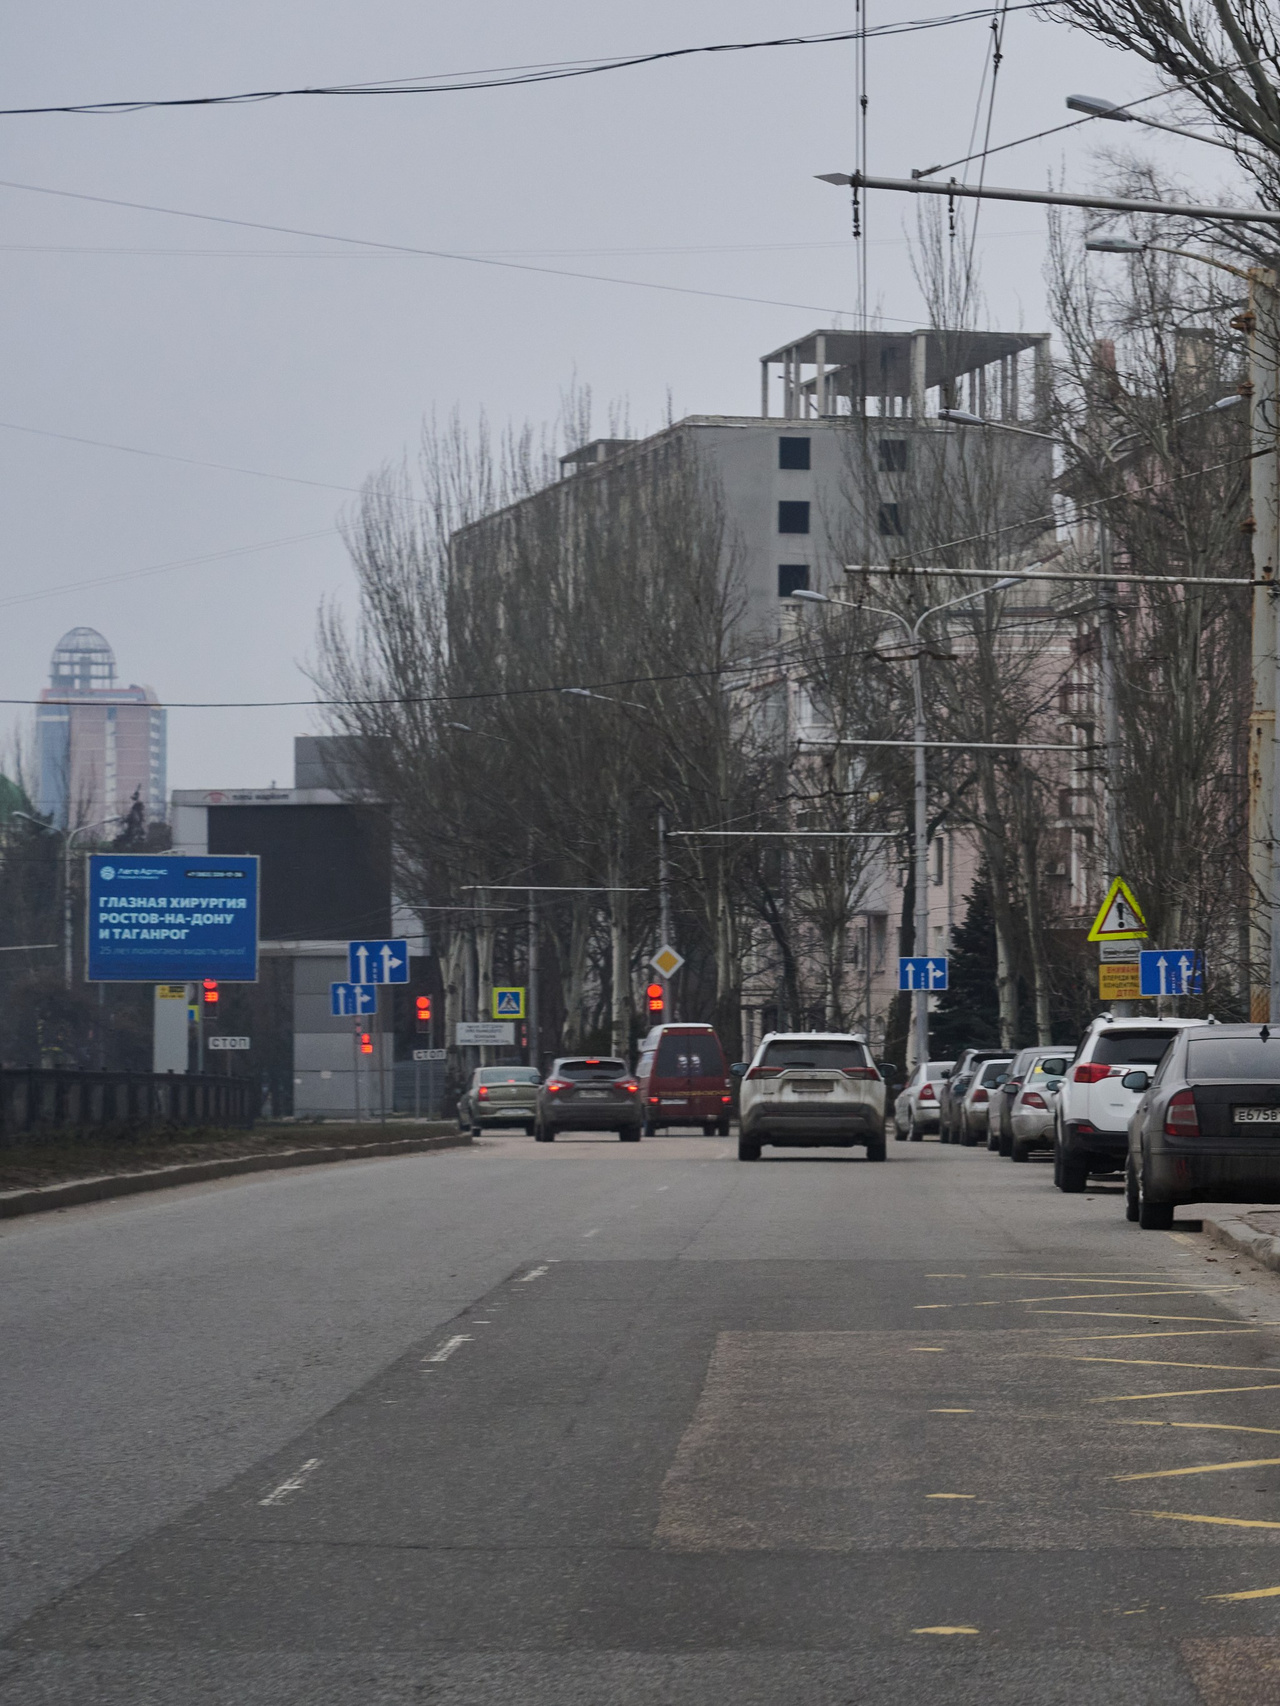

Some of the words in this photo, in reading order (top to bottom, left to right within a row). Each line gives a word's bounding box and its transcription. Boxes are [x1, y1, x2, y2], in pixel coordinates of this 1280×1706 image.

[99, 897, 167, 908] ГЛАЗНАЯ
[169, 897, 247, 909] ХИРУРГИЯ
[99, 913, 235, 926] РОСТОВ-НА-ДОНУ
[99, 929, 109, 939] И
[112, 929, 190, 940] ТАГАНРОГ
[212, 1038, 247, 1048] СТОП
[416, 1050, 444, 1060] СТОП
